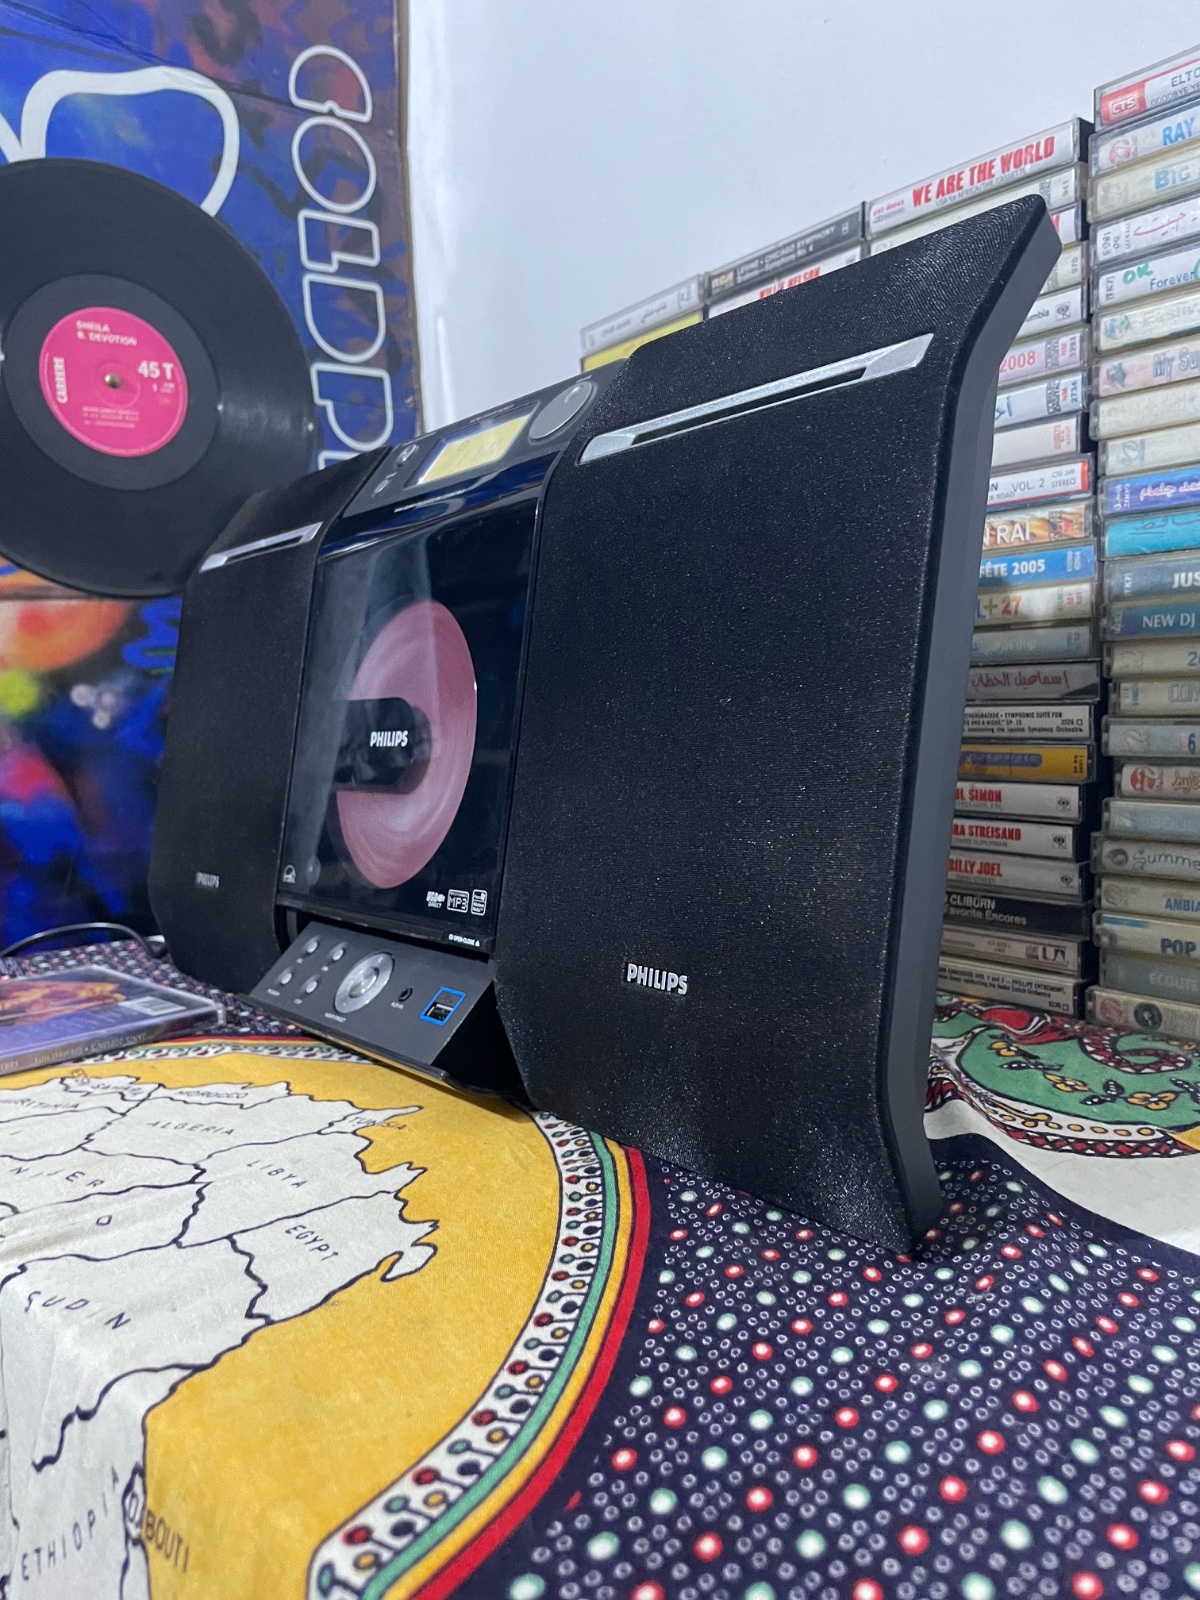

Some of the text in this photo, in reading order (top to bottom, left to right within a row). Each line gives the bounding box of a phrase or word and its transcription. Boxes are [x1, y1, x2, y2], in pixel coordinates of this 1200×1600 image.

[1110, 94, 1137, 116] CTS
[1150, 85, 1188, 107] GOODBYE
[1162, 116, 1195, 146] RAY
[912, 136, 1055, 208] WE ARE THE WORLD
[1154, 164, 1191, 190] BIG
[289, 44, 393, 470] COLDP
[1122, 262, 1153, 285] OK
[1149, 270, 1195, 291] Forever
[76, 320, 110, 332] SHEILA
[89, 332, 137, 347] DEVOTION
[138, 360, 174, 380] 45 T
[1000, 350, 1036, 373] 2008
[1178, 347, 1200, 372] Su
[1039, 478, 1045, 488] 2
[997, 521, 1030, 545] RAI
[1012, 559, 1046, 576] 2005
[1001, 595, 1022, 616] 27
[1142, 612, 1195, 629] NEW DJ
[370, 730, 409, 748] PHILIPS
[1188, 733, 1196, 755] 6
[968, 787, 1002, 803] SIMON
[969, 824, 1022, 841] STREISAND
[949, 858, 1002, 877] BILLY JOEL
[448, 896, 468, 910] MP3
[950, 893, 996, 910] CLIBURN
[985, 909, 1028, 926] Encores
[1160, 937, 1197, 956] POP
[626, 963, 688, 995] PHILIPS
[147, 1119, 235, 1136] ALGERIA
[247, 1160, 309, 1188] LIBYA
[285, 1224, 339, 1262] EGYPT
[21, 1465, 119, 1581] ETHIOPIA
